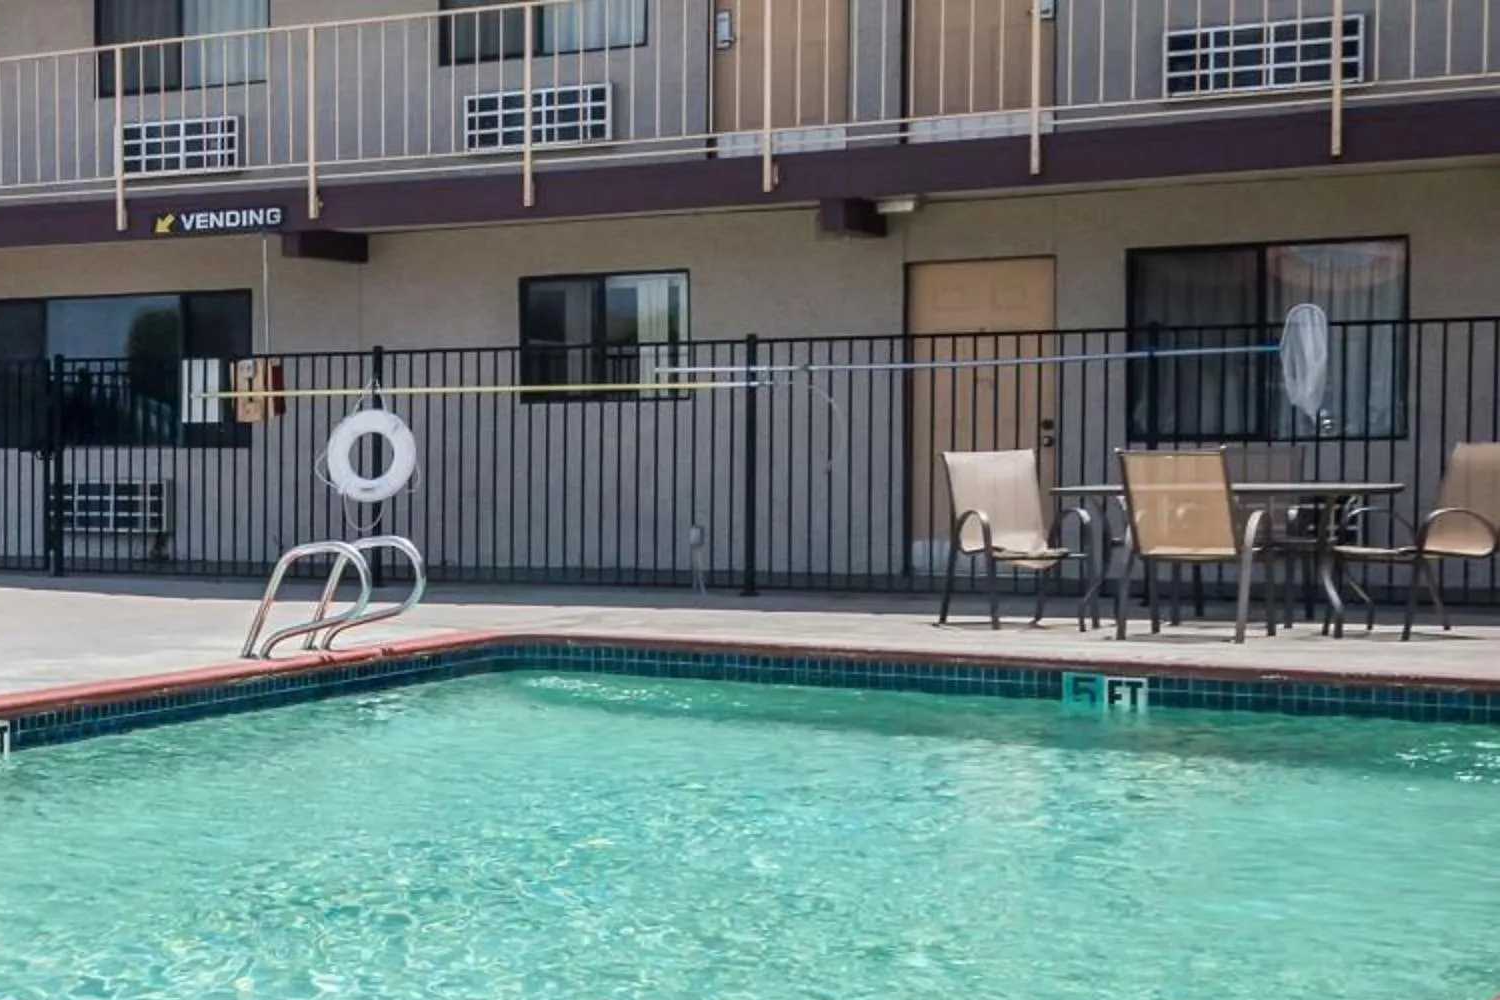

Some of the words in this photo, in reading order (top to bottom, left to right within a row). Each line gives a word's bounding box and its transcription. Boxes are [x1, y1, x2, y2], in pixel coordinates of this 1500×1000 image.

[181, 207, 282, 231] VENDING
[1071, 676, 1097, 707] 5
[1107, 679, 1143, 705] FT
